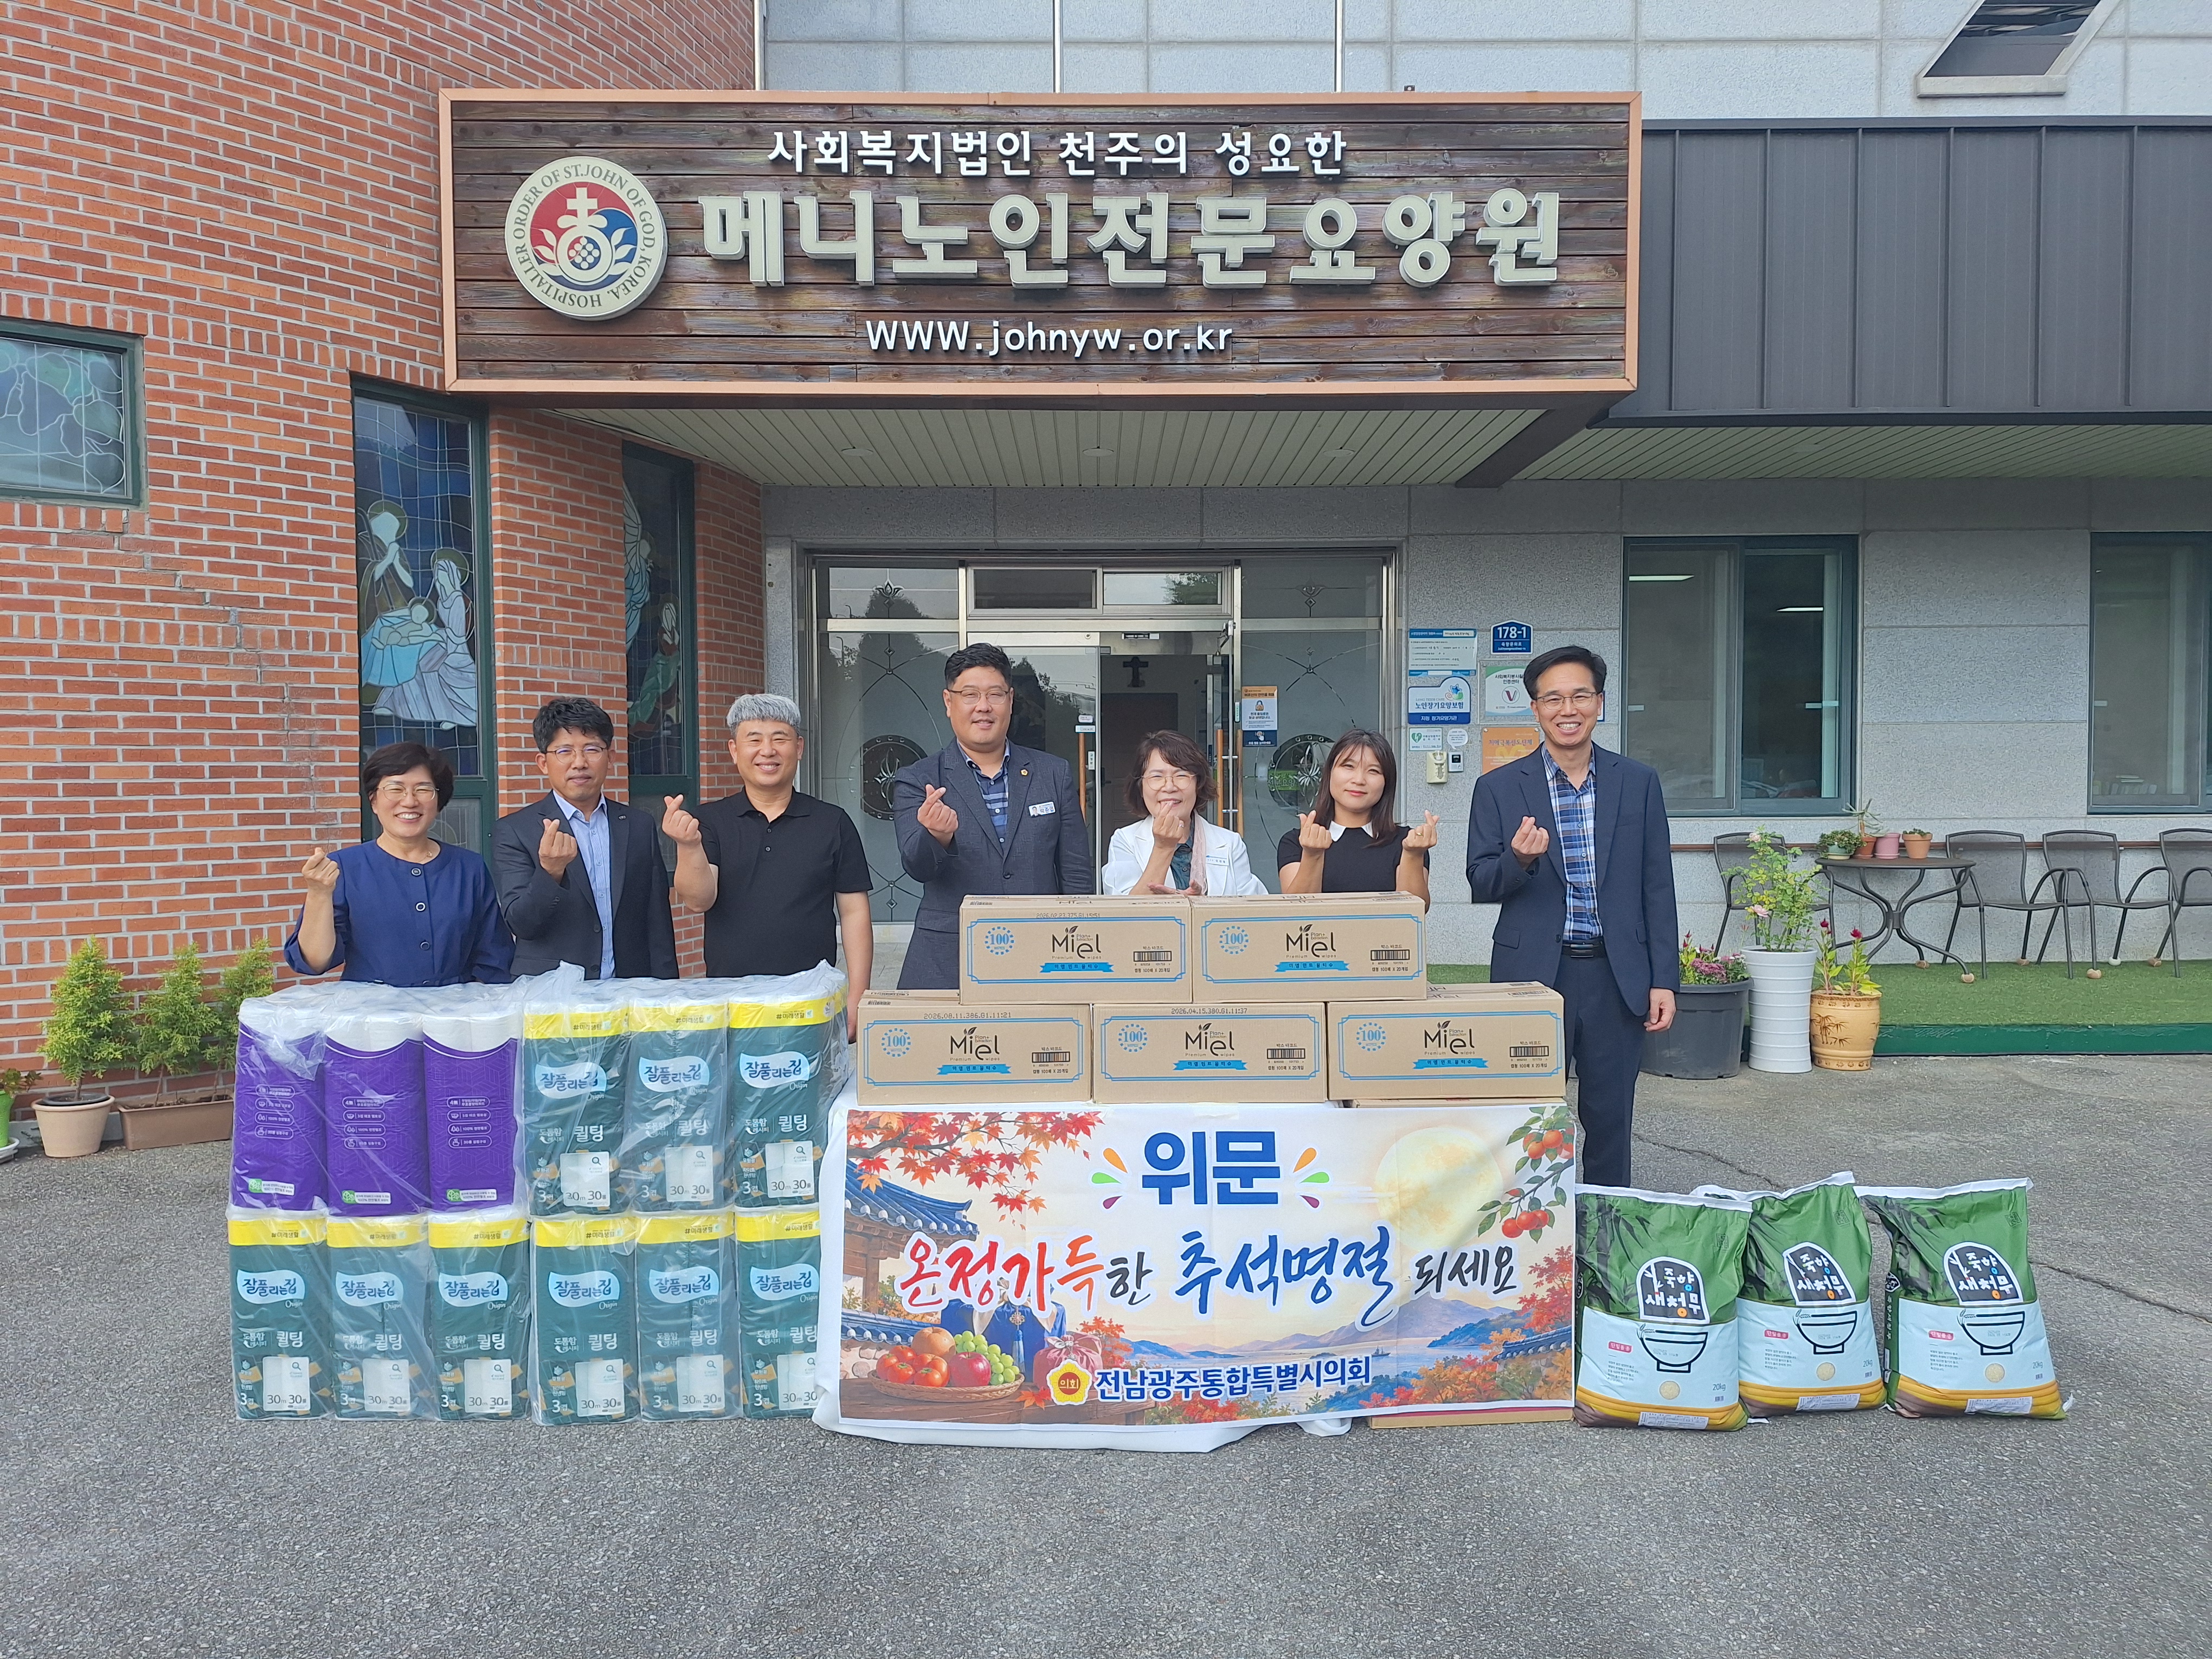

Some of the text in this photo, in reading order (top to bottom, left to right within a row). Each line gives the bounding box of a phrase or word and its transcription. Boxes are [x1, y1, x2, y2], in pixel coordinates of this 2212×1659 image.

[767, 130, 1347, 178] 사회복지법인 천주의 성요한
[541, 169, 561, 188] OF
[626, 188, 646, 208] OF
[513, 185, 543, 240] ORDER
[639, 210, 655, 252] GOD,
[700, 191, 1559, 287] 메니노인전문요양원
[516, 243, 602, 307] HOSPITALLER
[866, 318, 1233, 361] WWW.johnyw.or.kr
[1497, 627, 1526, 639] 178-1
[989, 934, 1009, 944] 100
[1052, 934, 1102, 959] Miel
[1224, 933, 1244, 944] 100
[1286, 932, 1336, 957] Miel
[886, 1036, 906, 1047] 100
[1123, 1031, 1142, 1042] 100
[1185, 1031, 1234, 1056] Miel
[1361, 1030, 1381, 1041] 100
[1424, 1028, 1475, 1054] Miel
[950, 1034, 1000, 1060] Miel
[644, 1063, 701, 1084] 잘풀리는집
[744, 1059, 801, 1081] 잘풀리는집
[789, 1082, 808, 1090] Origin
[678, 1118, 709, 1136] 퀼팅
[778, 1114, 807, 1133] 퀼팅
[574, 1124, 603, 1143] 퀼팅
[1141, 1130, 1280, 1206] 위문
[670, 1185, 689, 1195] 30m
[771, 1181, 790, 1191] 30m
[565, 1192, 586, 1201] 30m
[1799, 1253, 1831, 1275] 죽향
[1966, 1252, 1999, 1275] 죽향
[755, 1271, 812, 1293] 잘풀리는집
[902, 1224, 1517, 1323] 온정가득한 추석명절 되세요
[1664, 1268, 1695, 1292] 죽향
[242, 1278, 296, 1297] 잘풀리는집
[340, 1279, 395, 1299] 잘풀리는집
[444, 1279, 499, 1300] 잘풀리는집
[554, 1278, 611, 1300] 잘풀리는집
[654, 1274, 710, 1296] 잘풀리는집
[1797, 1275, 1846, 1300] 새청무
[1958, 1275, 2014, 1300] 새청무
[488, 1302, 506, 1310] Origin
[599, 1301, 618, 1310] Origin
[699, 1296, 717, 1306] Origin
[800, 1294, 818, 1303] Origin
[1645, 1291, 1701, 1317] 새청무
[276, 1330, 303, 1348] 퀼팅
[375, 1334, 402, 1351] 퀼팅
[477, 1333, 505, 1350] 퀼팅
[588, 1333, 618, 1351] 퀼팅
[689, 1329, 717, 1346] 퀼팅
[789, 1325, 817, 1344] 퀼팅
[1059, 1378, 1078, 1390] 의회
[1096, 1356, 1372, 1402] 전남광주통합특별시의회
[1713, 1383, 1726, 1391] 20kg
[267, 1394, 286, 1404] 30m
[368, 1396, 387, 1404] 30m
[468, 1397, 488, 1406] 30m
[581, 1400, 601, 1409] 30m
[682, 1395, 702, 1405] 30m
[754, 1393, 769, 1406] 3겹
[783, 1392, 802, 1403] 30m
